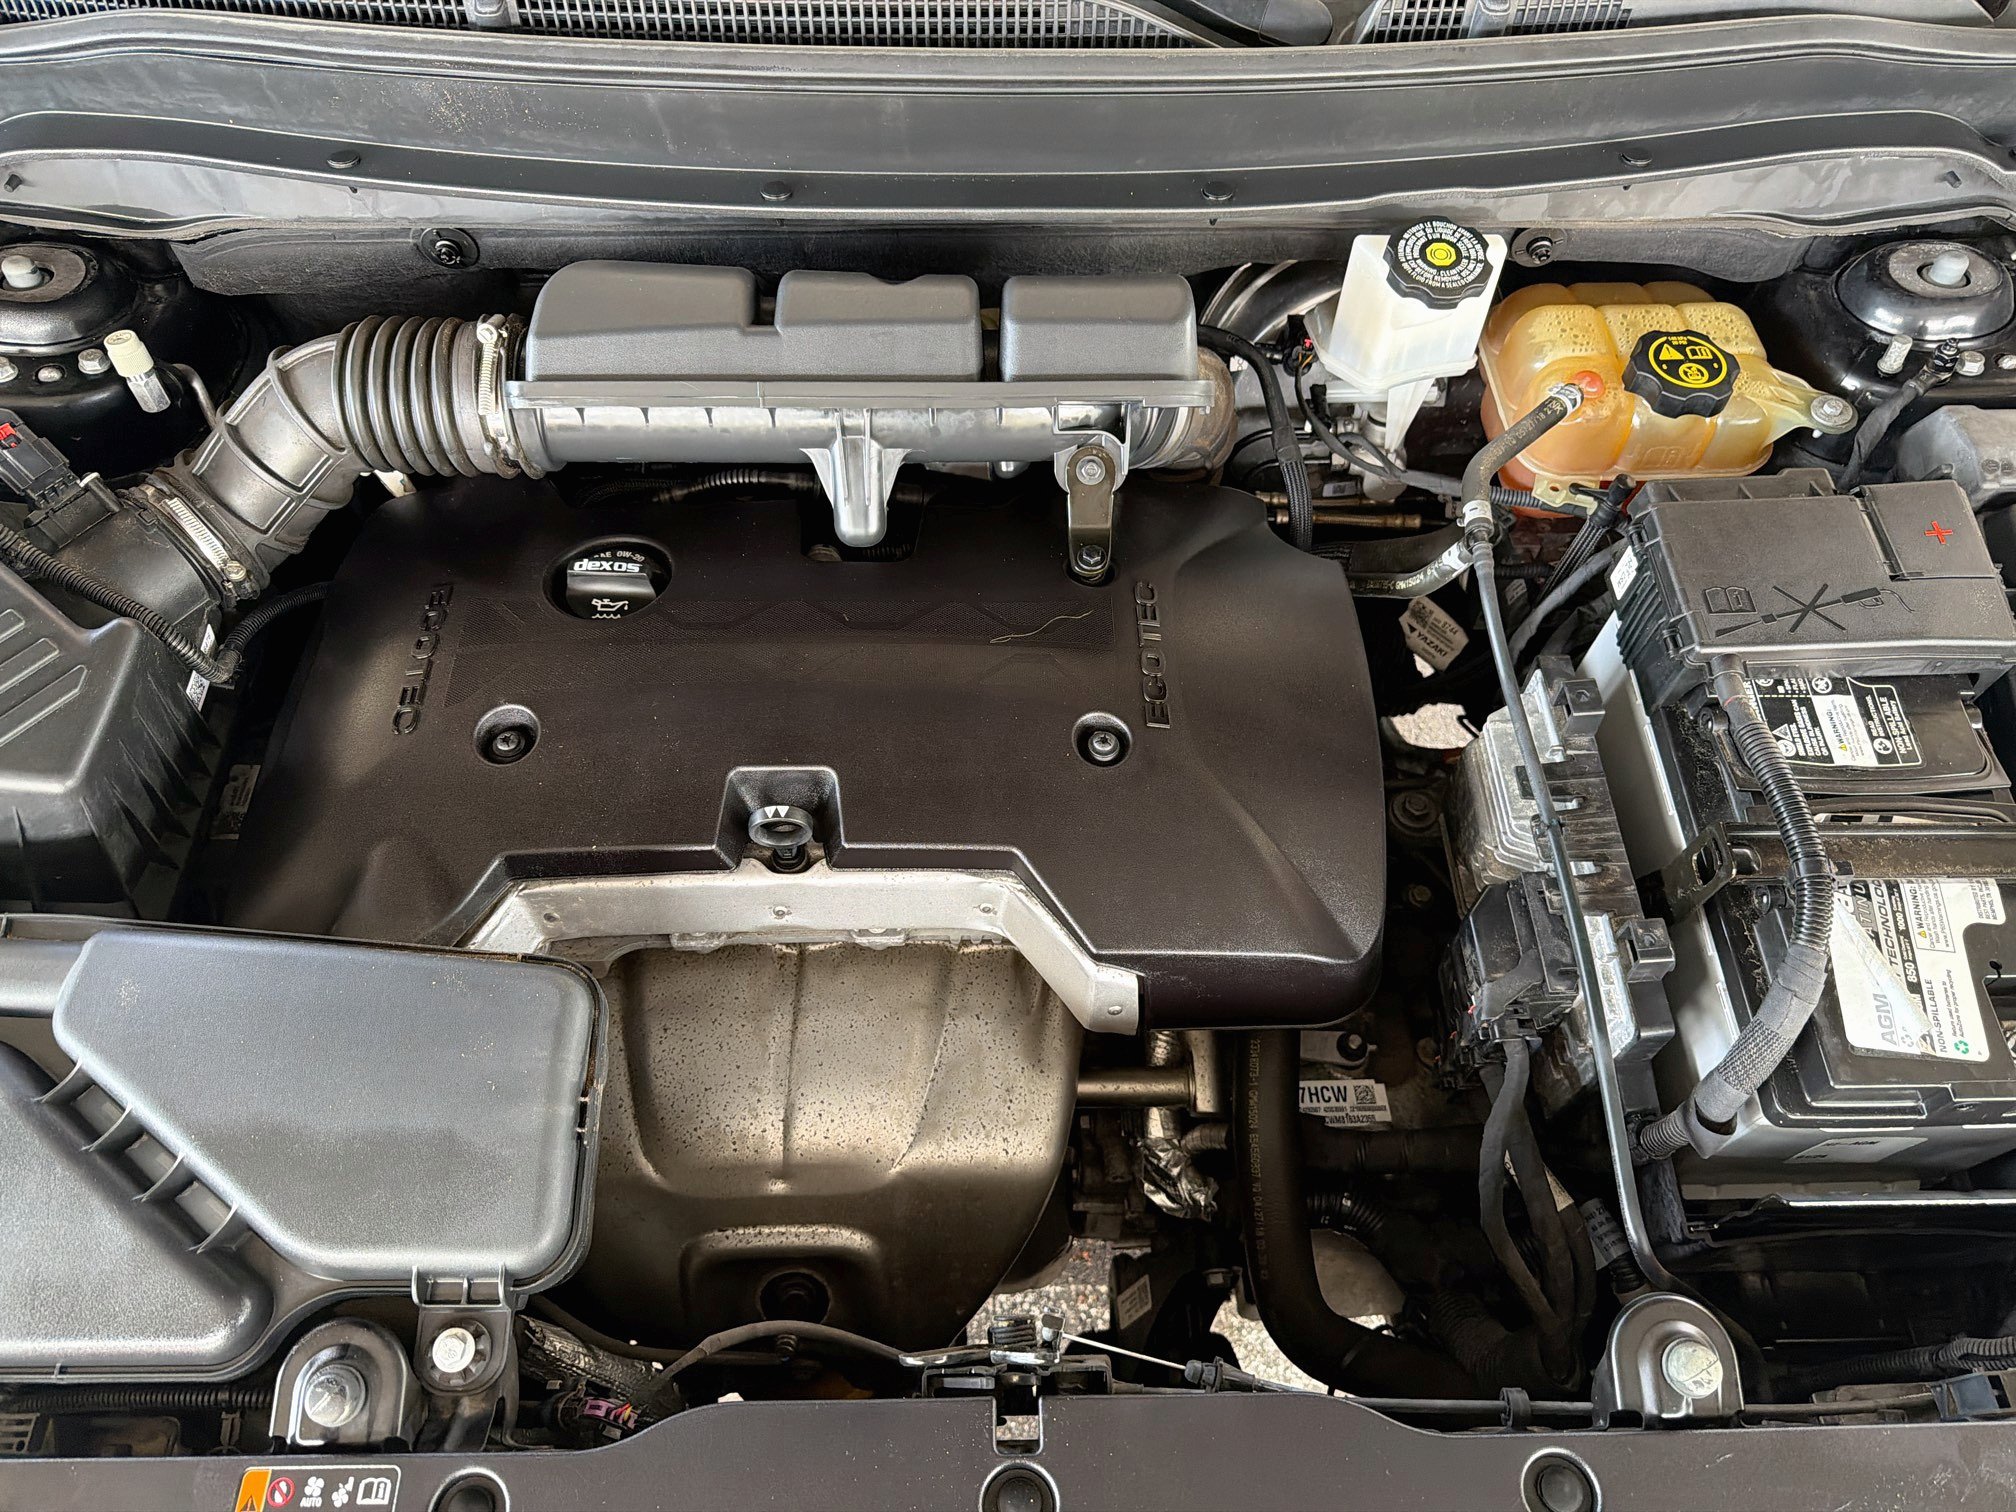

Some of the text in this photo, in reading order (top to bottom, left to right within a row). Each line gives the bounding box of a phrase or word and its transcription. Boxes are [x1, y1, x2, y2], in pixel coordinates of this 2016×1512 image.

[1457, 228, 1473, 239] AVANT
[1412, 271, 1425, 282] FLUID
[1425, 279, 1440, 288] FROM
[1446, 279, 1465, 288] SEALED
[1415, 266, 1433, 280] BEFORE
[574, 558, 642, 573] dexos
[616, 550, 645, 562] 0W-20
[1417, 632, 1446, 657] YAZAKI
[392, 582, 454, 735] ECOTEC
[1134, 580, 1172, 730] ECOTEC
[1789, 699, 1799, 710] CAN
[1799, 706, 1821, 755] CAUSE BLINDNESS
[1868, 720, 1878, 736] READ
[1879, 696, 1907, 753] NON-SPILLABLE
[1888, 700, 1912, 749] Lead Acid Battery
[1799, 729, 1814, 755] EXPLOSIVE
[1820, 746, 1828, 755] OR
[1908, 885, 1924, 928] WARNING:
[1917, 892, 1928, 921] Reproductive
[1922, 885, 1940, 943] Wash hands after handling
[1972, 892, 1983, 918] DISTRIBUTED
[1895, 912, 1906, 930] 1000
[1923, 921, 1931, 931] and
[1926, 931, 1935, 948] Cancer
[1903, 961, 1917, 982] 850
[1944, 968, 1955, 989] recycling
[1942, 986, 1952, 1006] batteries
[1949, 990, 1959, 1006] proper
[1872, 993, 1897, 1045] AGM
[1924, 978, 1947, 1052] NON-SPILLABLE
[1946, 1007, 1954, 1019] used
[1948, 1020, 1958, 1036] Return
[1954, 1014, 1964, 1037] AutoZone
[1300, 1086, 1347, 1103] 7HCW
[299, 1496, 322, 1507] AUTO
